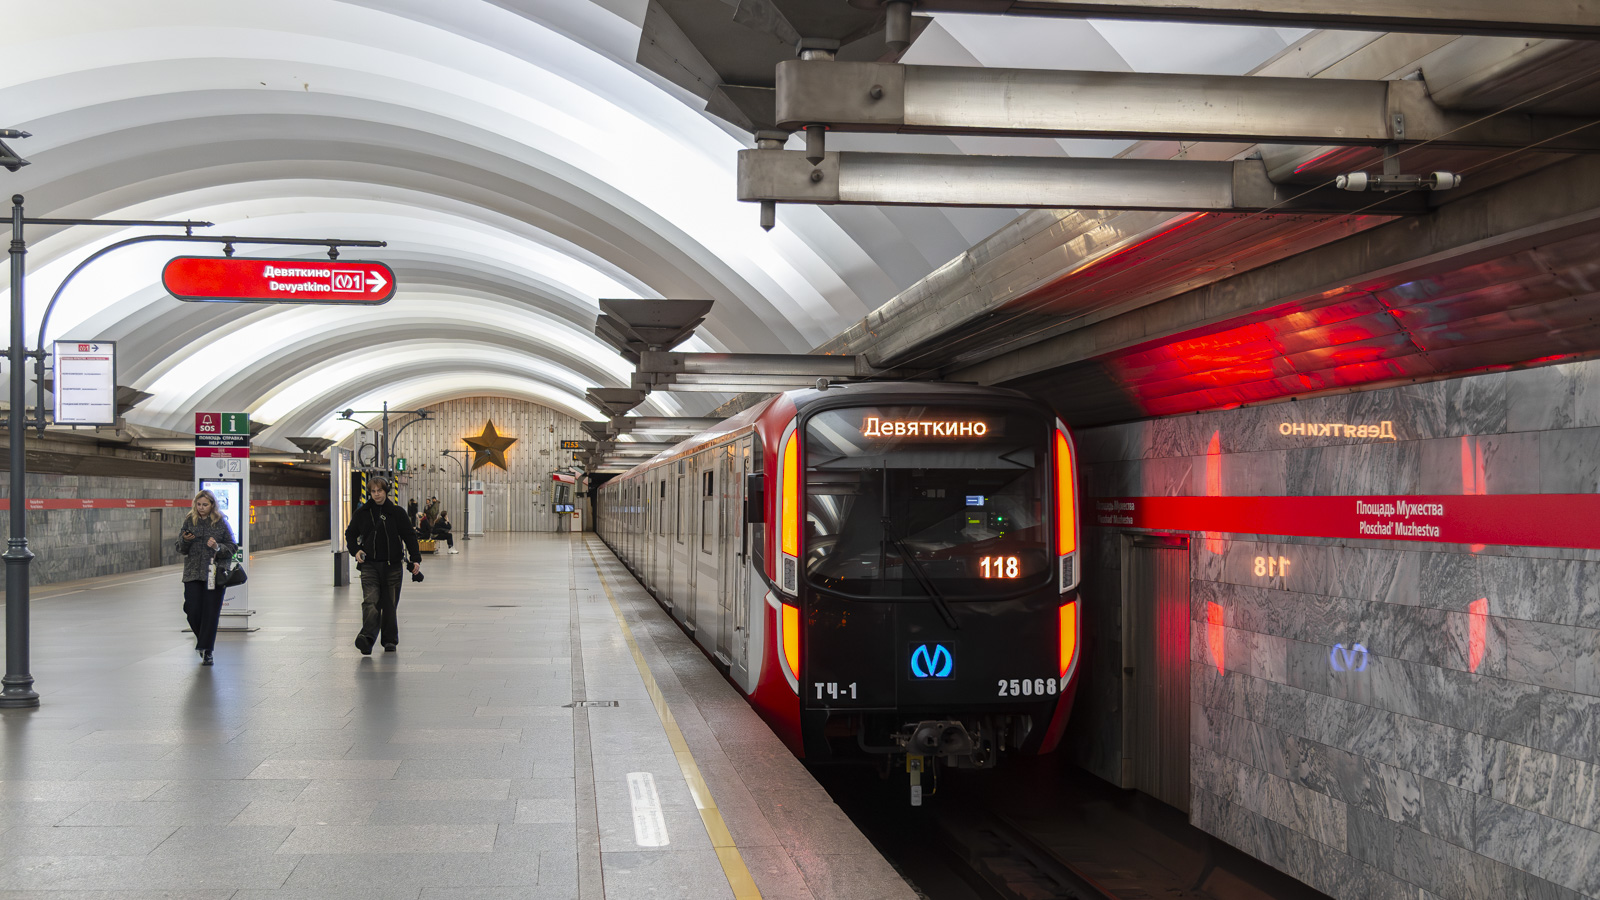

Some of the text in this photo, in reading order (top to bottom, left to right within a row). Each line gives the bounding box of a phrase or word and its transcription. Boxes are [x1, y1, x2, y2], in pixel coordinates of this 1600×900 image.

[264, 265, 331, 278] Девяткино
[270, 281, 331, 293] Devyatkino
[863, 416, 988, 437] Девяткино
[1356, 500, 1444, 519] Площадь Мужества
[1359, 521, 1440, 537] Ploschad' Muzhestva
[980, 556, 1019, 578] 118
[814, 682, 857, 700] ТЧ-1
[997, 677, 1057, 697] 25068
